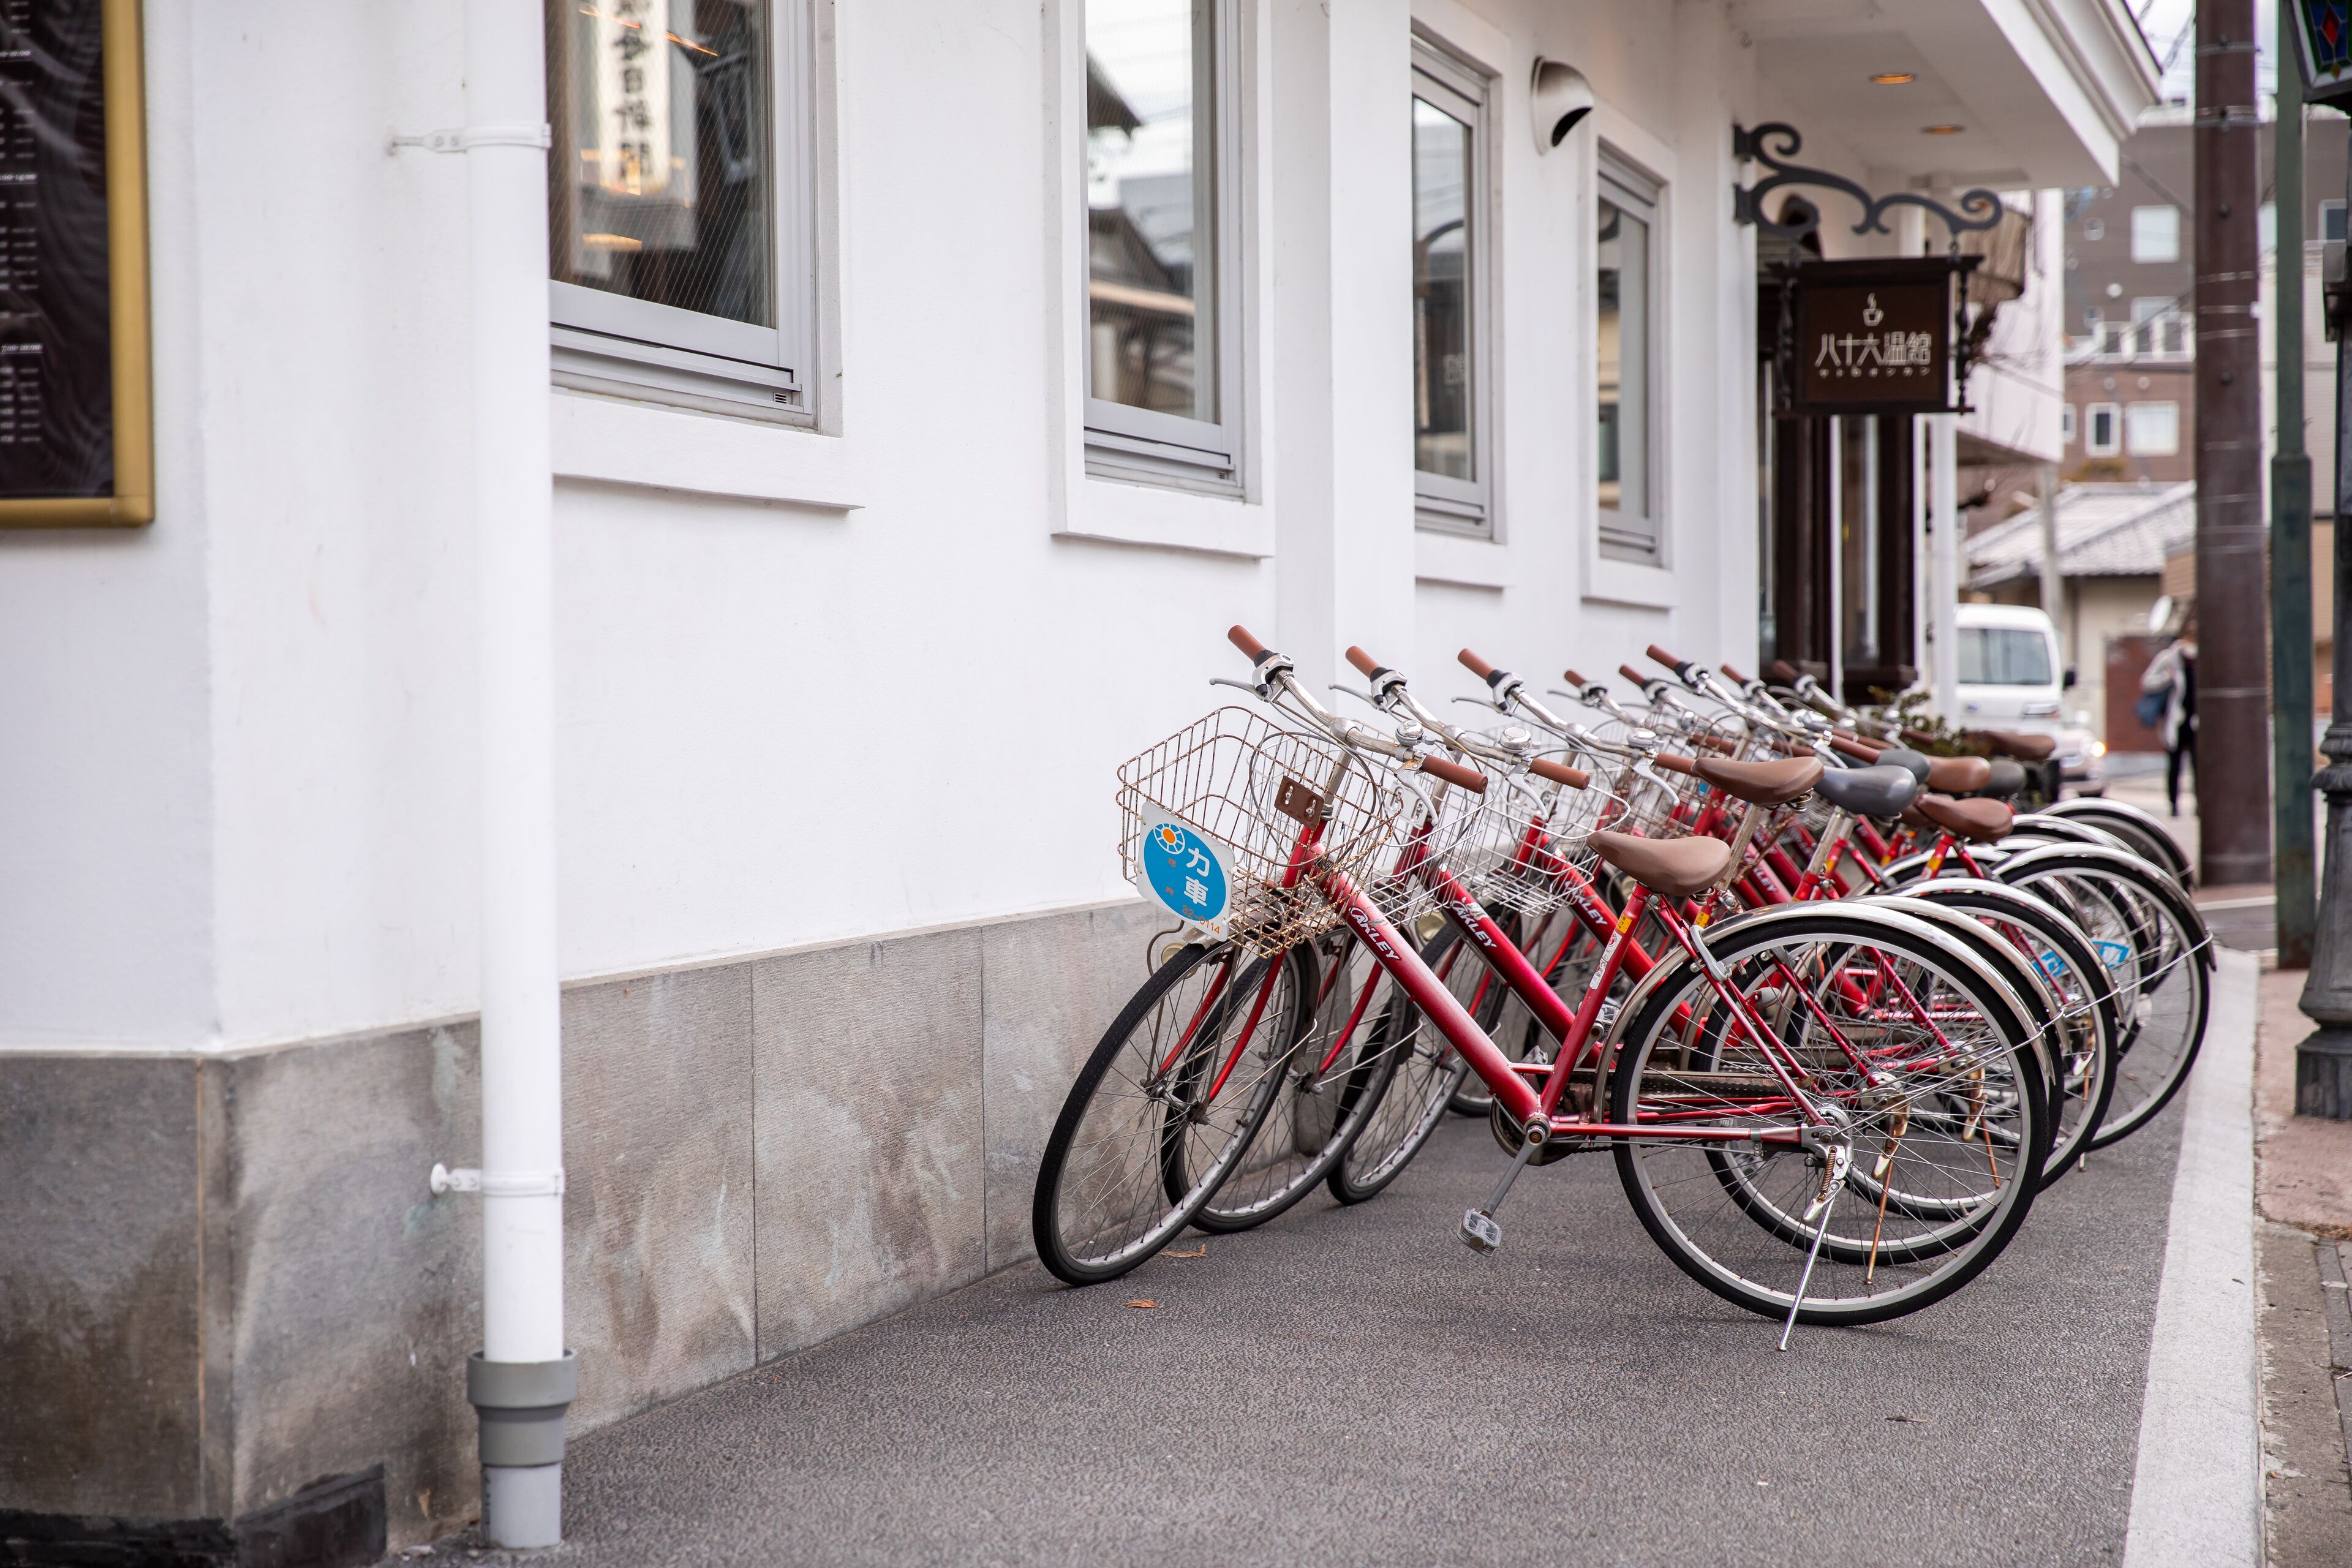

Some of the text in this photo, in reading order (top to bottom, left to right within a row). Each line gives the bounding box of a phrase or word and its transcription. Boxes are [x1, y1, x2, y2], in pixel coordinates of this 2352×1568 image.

[1183, 847, 1210, 907] 力車
[1182, 905, 1220, 935] 32-0114
[1348, 907, 1401, 960] OAKLEY
[1449, 900, 1498, 948] OAKLEY
